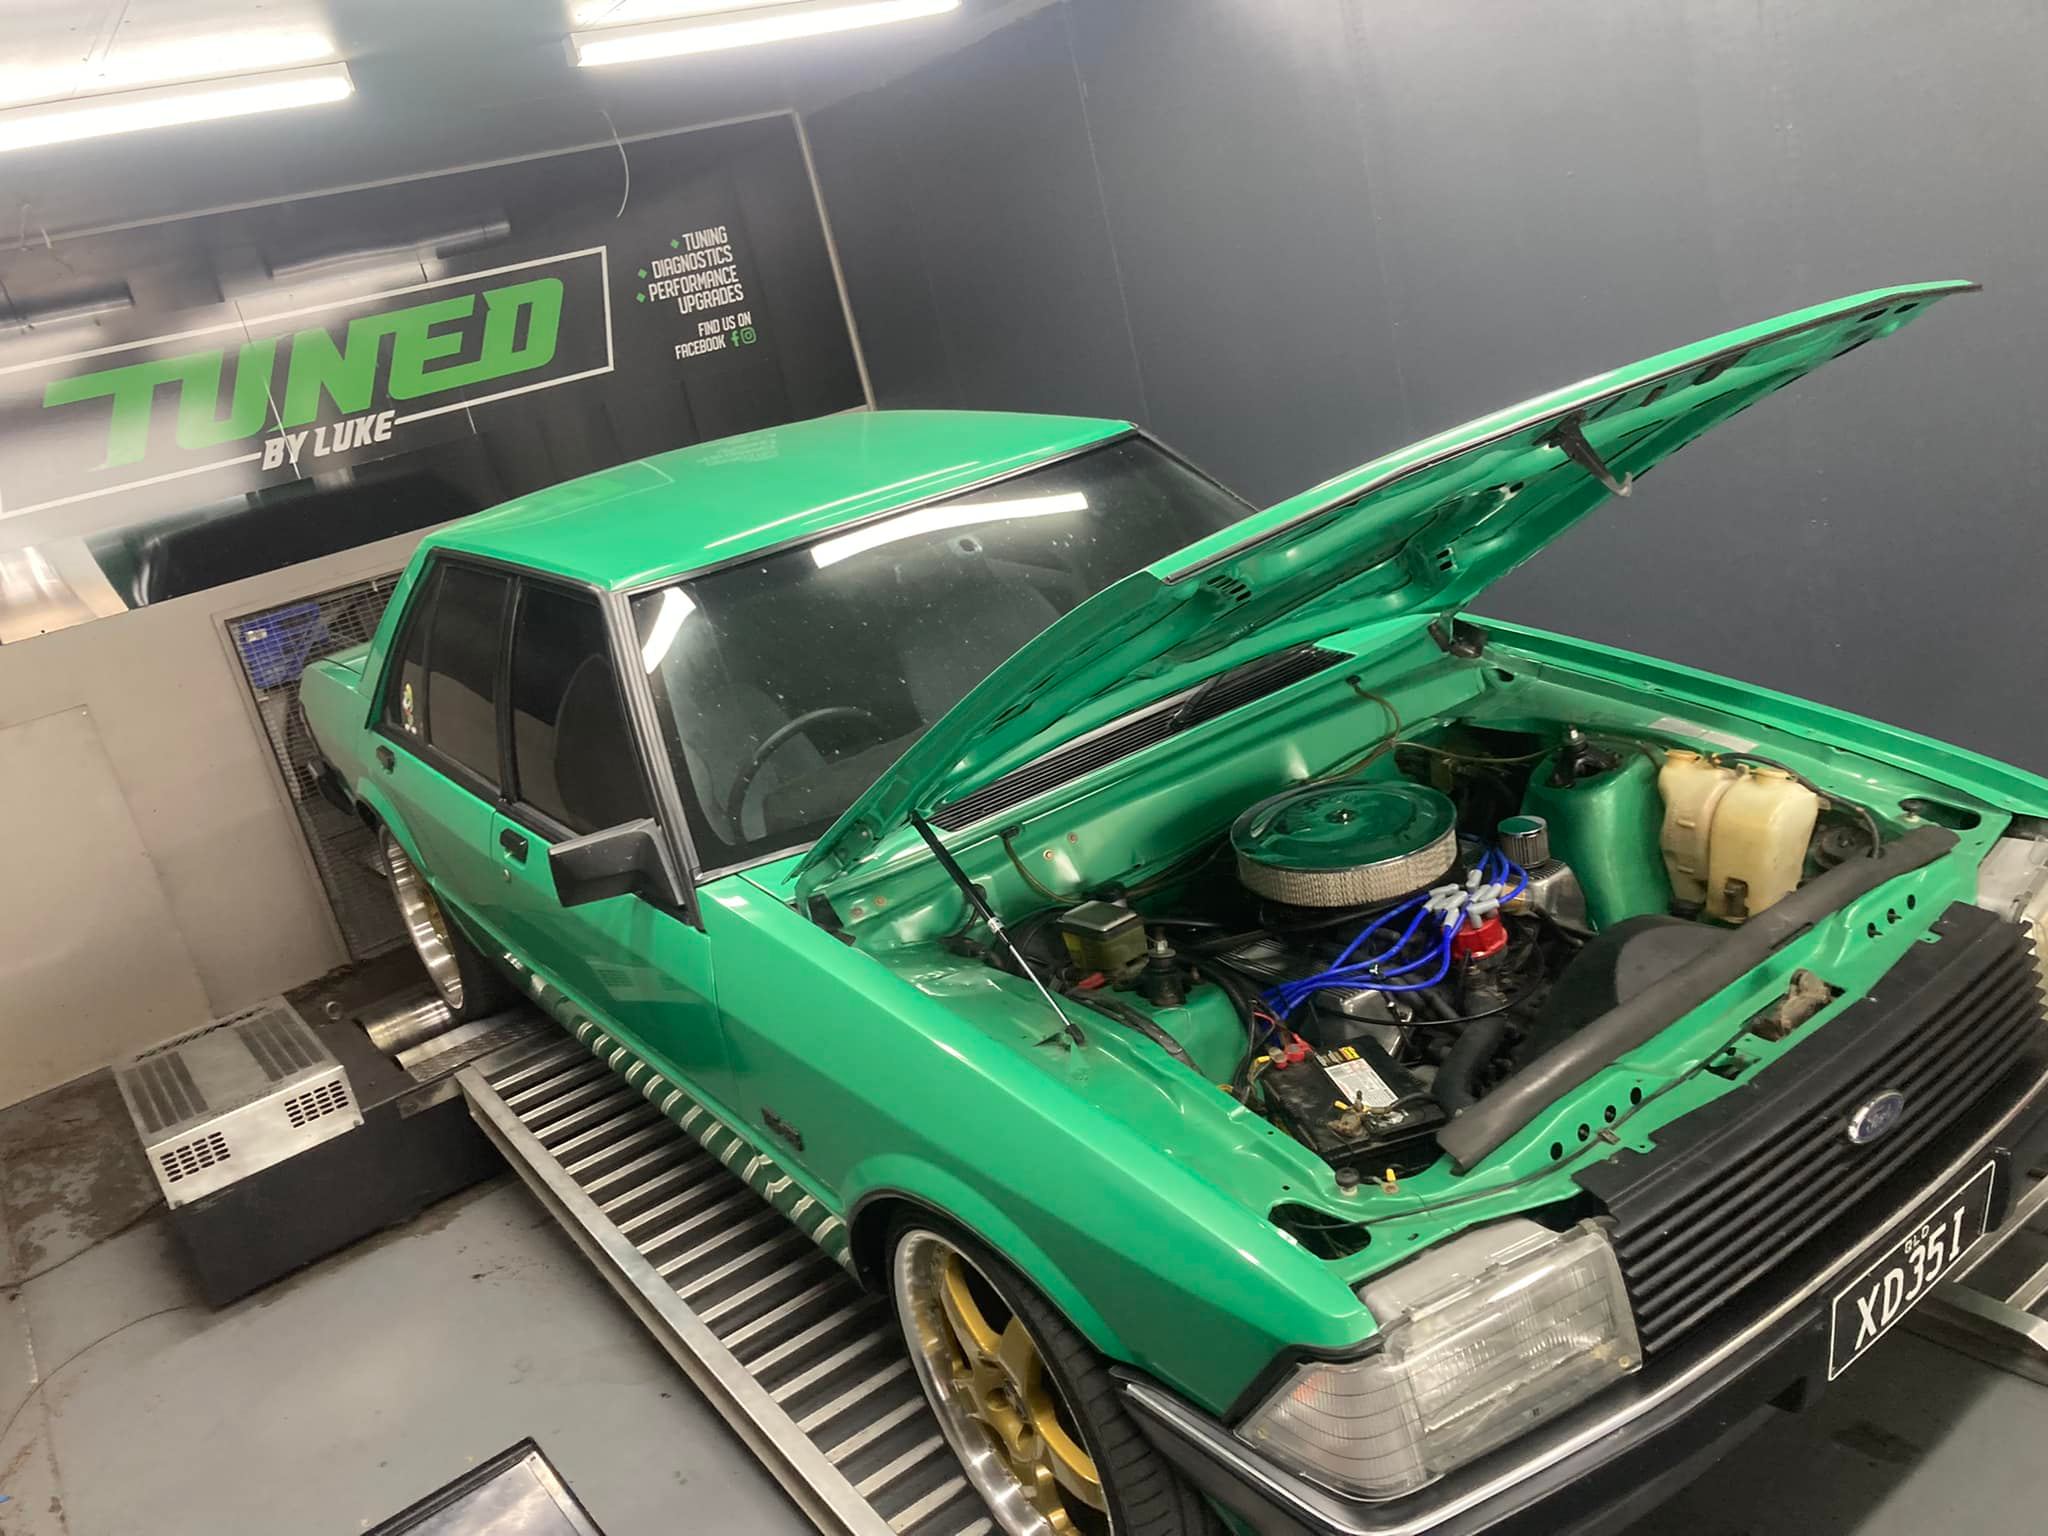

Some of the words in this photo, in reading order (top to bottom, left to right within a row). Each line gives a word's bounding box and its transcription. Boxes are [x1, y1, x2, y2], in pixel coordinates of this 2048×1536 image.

[682, 226, 728, 251] TUNING
[651, 246, 733, 279] DIAGNOSTICS
[648, 265, 739, 302] PERFORMANCE
[677, 284, 744, 314] UPGRADES
[698, 320, 721, 337] FIND
[721, 316, 736, 331] US
[737, 312, 752, 328] ON
[675, 334, 726, 360] FACEBOOK
[42, 277, 564, 471] TUNED
[262, 433, 304, 471] BY
[313, 410, 395, 456] LUKE
[1904, 1225, 1930, 1254] QLD
